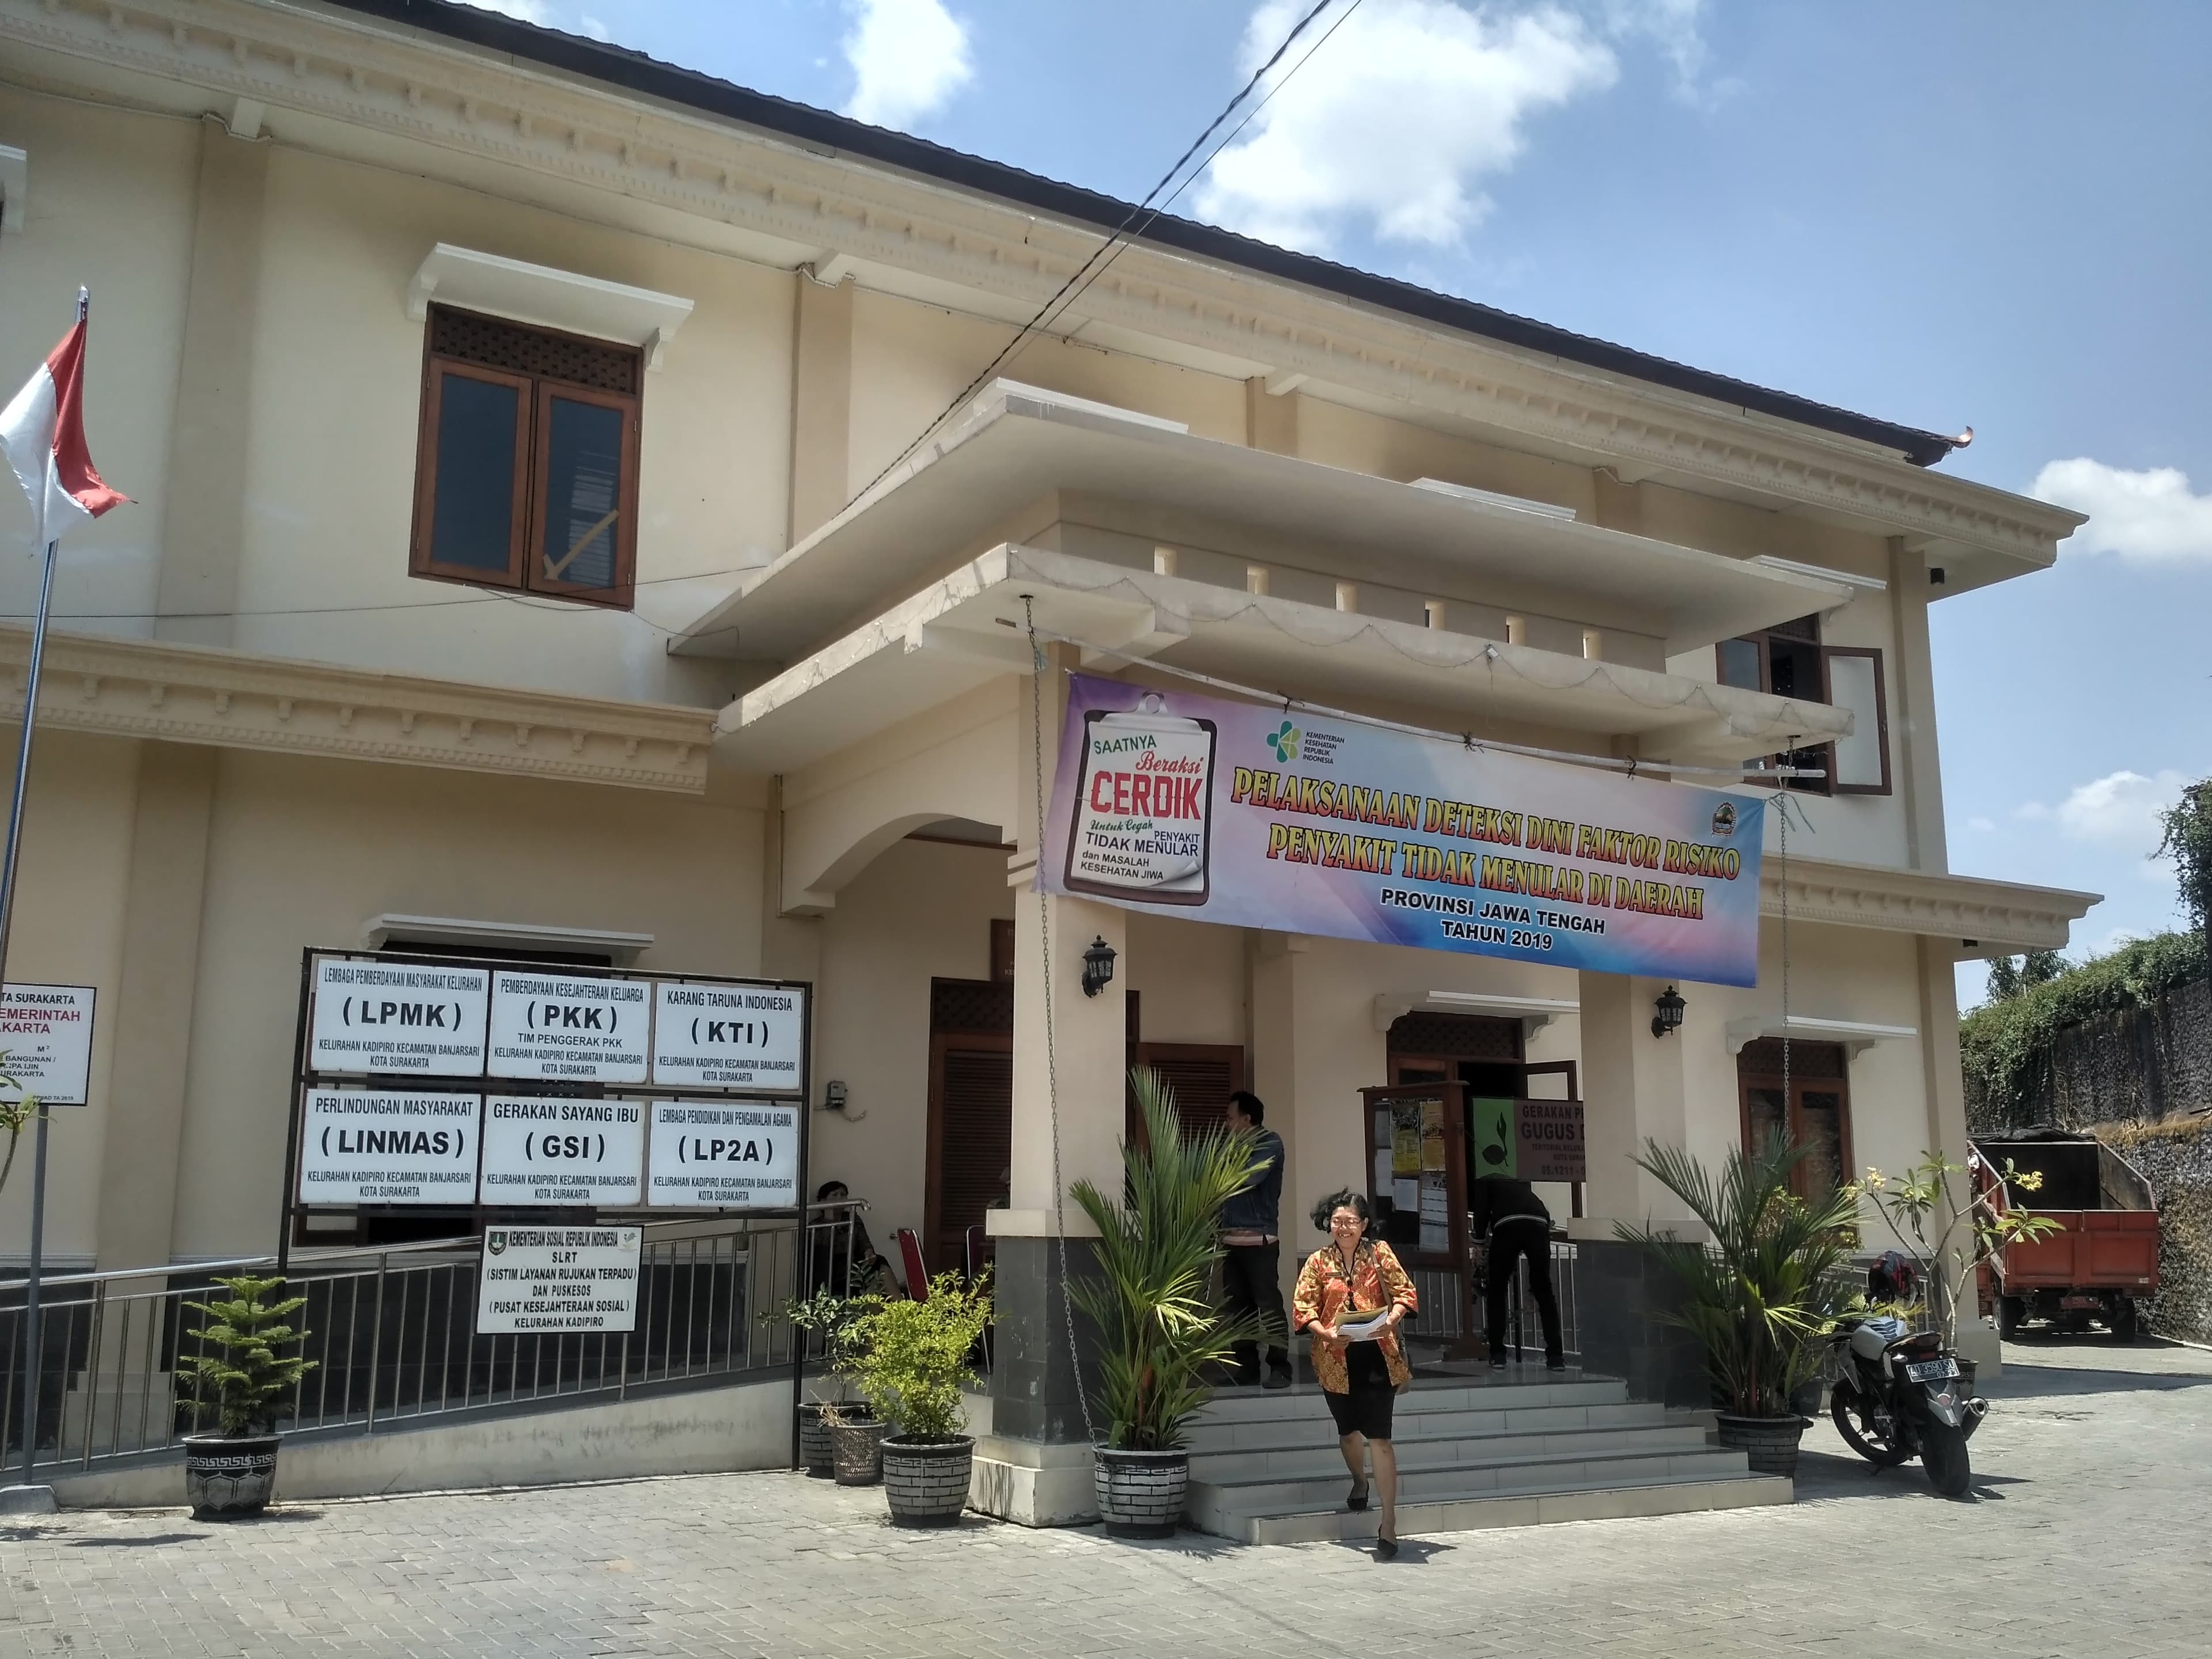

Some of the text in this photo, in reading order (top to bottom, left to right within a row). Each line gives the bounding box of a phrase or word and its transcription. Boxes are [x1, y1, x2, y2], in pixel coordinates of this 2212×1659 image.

[1094, 734, 1157, 755] SAATNYA
[1305, 738, 1337, 750] KESEHATAN
[1306, 731, 1345, 744] KEMENTERIAN
[1302, 754, 1334, 764] INDONESIA
[1304, 747, 1330, 757] REPUBLIK
[1135, 750, 1204, 775] Beraksi
[1090, 770, 1203, 821] CERDIK
[1090, 819, 1153, 835] Untuk Cegah
[1230, 767, 1741, 881] PELAKSANAAN DETEKSI DINI FAKTOR RISIKO
[1086, 831, 1199, 857] TIDAK MENULAR
[1154, 830, 1200, 844] PENYAKIT
[1082, 851, 1150, 867] dan MASALAH
[1080, 861, 1164, 880] KESEHATAN JIWA
[1267, 824, 1704, 921] PENYAKIT TIDAK MENULAR DI DAERAH
[1381, 889, 1605, 935] PROVINSI JAWA TENGAH
[1441, 920, 1553, 950] TAHUN 2019
[324, 967, 482, 992] LEMBAGA PEMBERDAYAAN MASYARAKAT KELURAHAN
[501, 978, 643, 1003] PEMBERDAYAAN KESEJAHTERAAN KELUARGA
[16, 993, 75, 1005] SURAKARTA
[667, 990, 792, 1011] KARANG TARUNA INDONESIA
[0, 1022, 50, 1033] KARTA
[319, 1039, 479, 1057] KELURAHAN KADIPIRO KECAMATAN BANJARSARI
[518, 1033, 623, 1048] TIM PENGGERAK PKK
[370, 1056, 429, 1069] KOTA SURAKARTA
[494, 1047, 643, 1065] KELURAHAN KADIPIRO KECAMATAN BANJARSARI
[658, 1056, 795, 1071] KELURAHAN KADIPIRO KECAMATAN BANJARSARI
[541, 1063, 596, 1075] KOTA SURAKARTA
[702, 1071, 753, 1082] KOTA SURAKARTA
[315, 1097, 473, 1117] PERLINDUNGAN MASYARAKAT
[493, 1103, 639, 1123] GERAKAN SAYANG IBU
[1522, 1105, 1571, 1119] GERAKAN
[659, 1108, 792, 1127] LEMBAGA PENDIDIKAN DAN PENGAMALAN AGAMA
[1521, 1122, 1575, 1140] GUGUS
[308, 1171, 471, 1184] KELURAHAN KADIPIRO KECAMATAN BANJARSARI
[487, 1173, 637, 1187] KELURAHAN KADIPIRO KECAMATAN BANJARSARI
[654, 1176, 792, 1189] KELURAHAN KADIPIRO KECAMATAN BANJARSARI
[359, 1186, 420, 1198] KOTA SURAKARTA
[535, 1188, 590, 1200] KOTA SURAKARTA
[698, 1190, 749, 1202] KOTA SURAKARTA
[509, 1230, 618, 1247] KEMENTERIAN SOSIAL REPUBLIK INDONESIA
[552, 1252, 578, 1263] SLRT
[487, 1268, 637, 1281] (SISTIM LAYANAN RUJUKAN TERPADU)
[532, 1285, 591, 1297] DAN PUSKESOS
[524, 1300, 593, 1313] KESEJAHTERAAN
[514, 1317, 604, 1328] KELURAHAN KADIPIRO
[1910, 1359, 1955, 1375] AD 3590 SU
